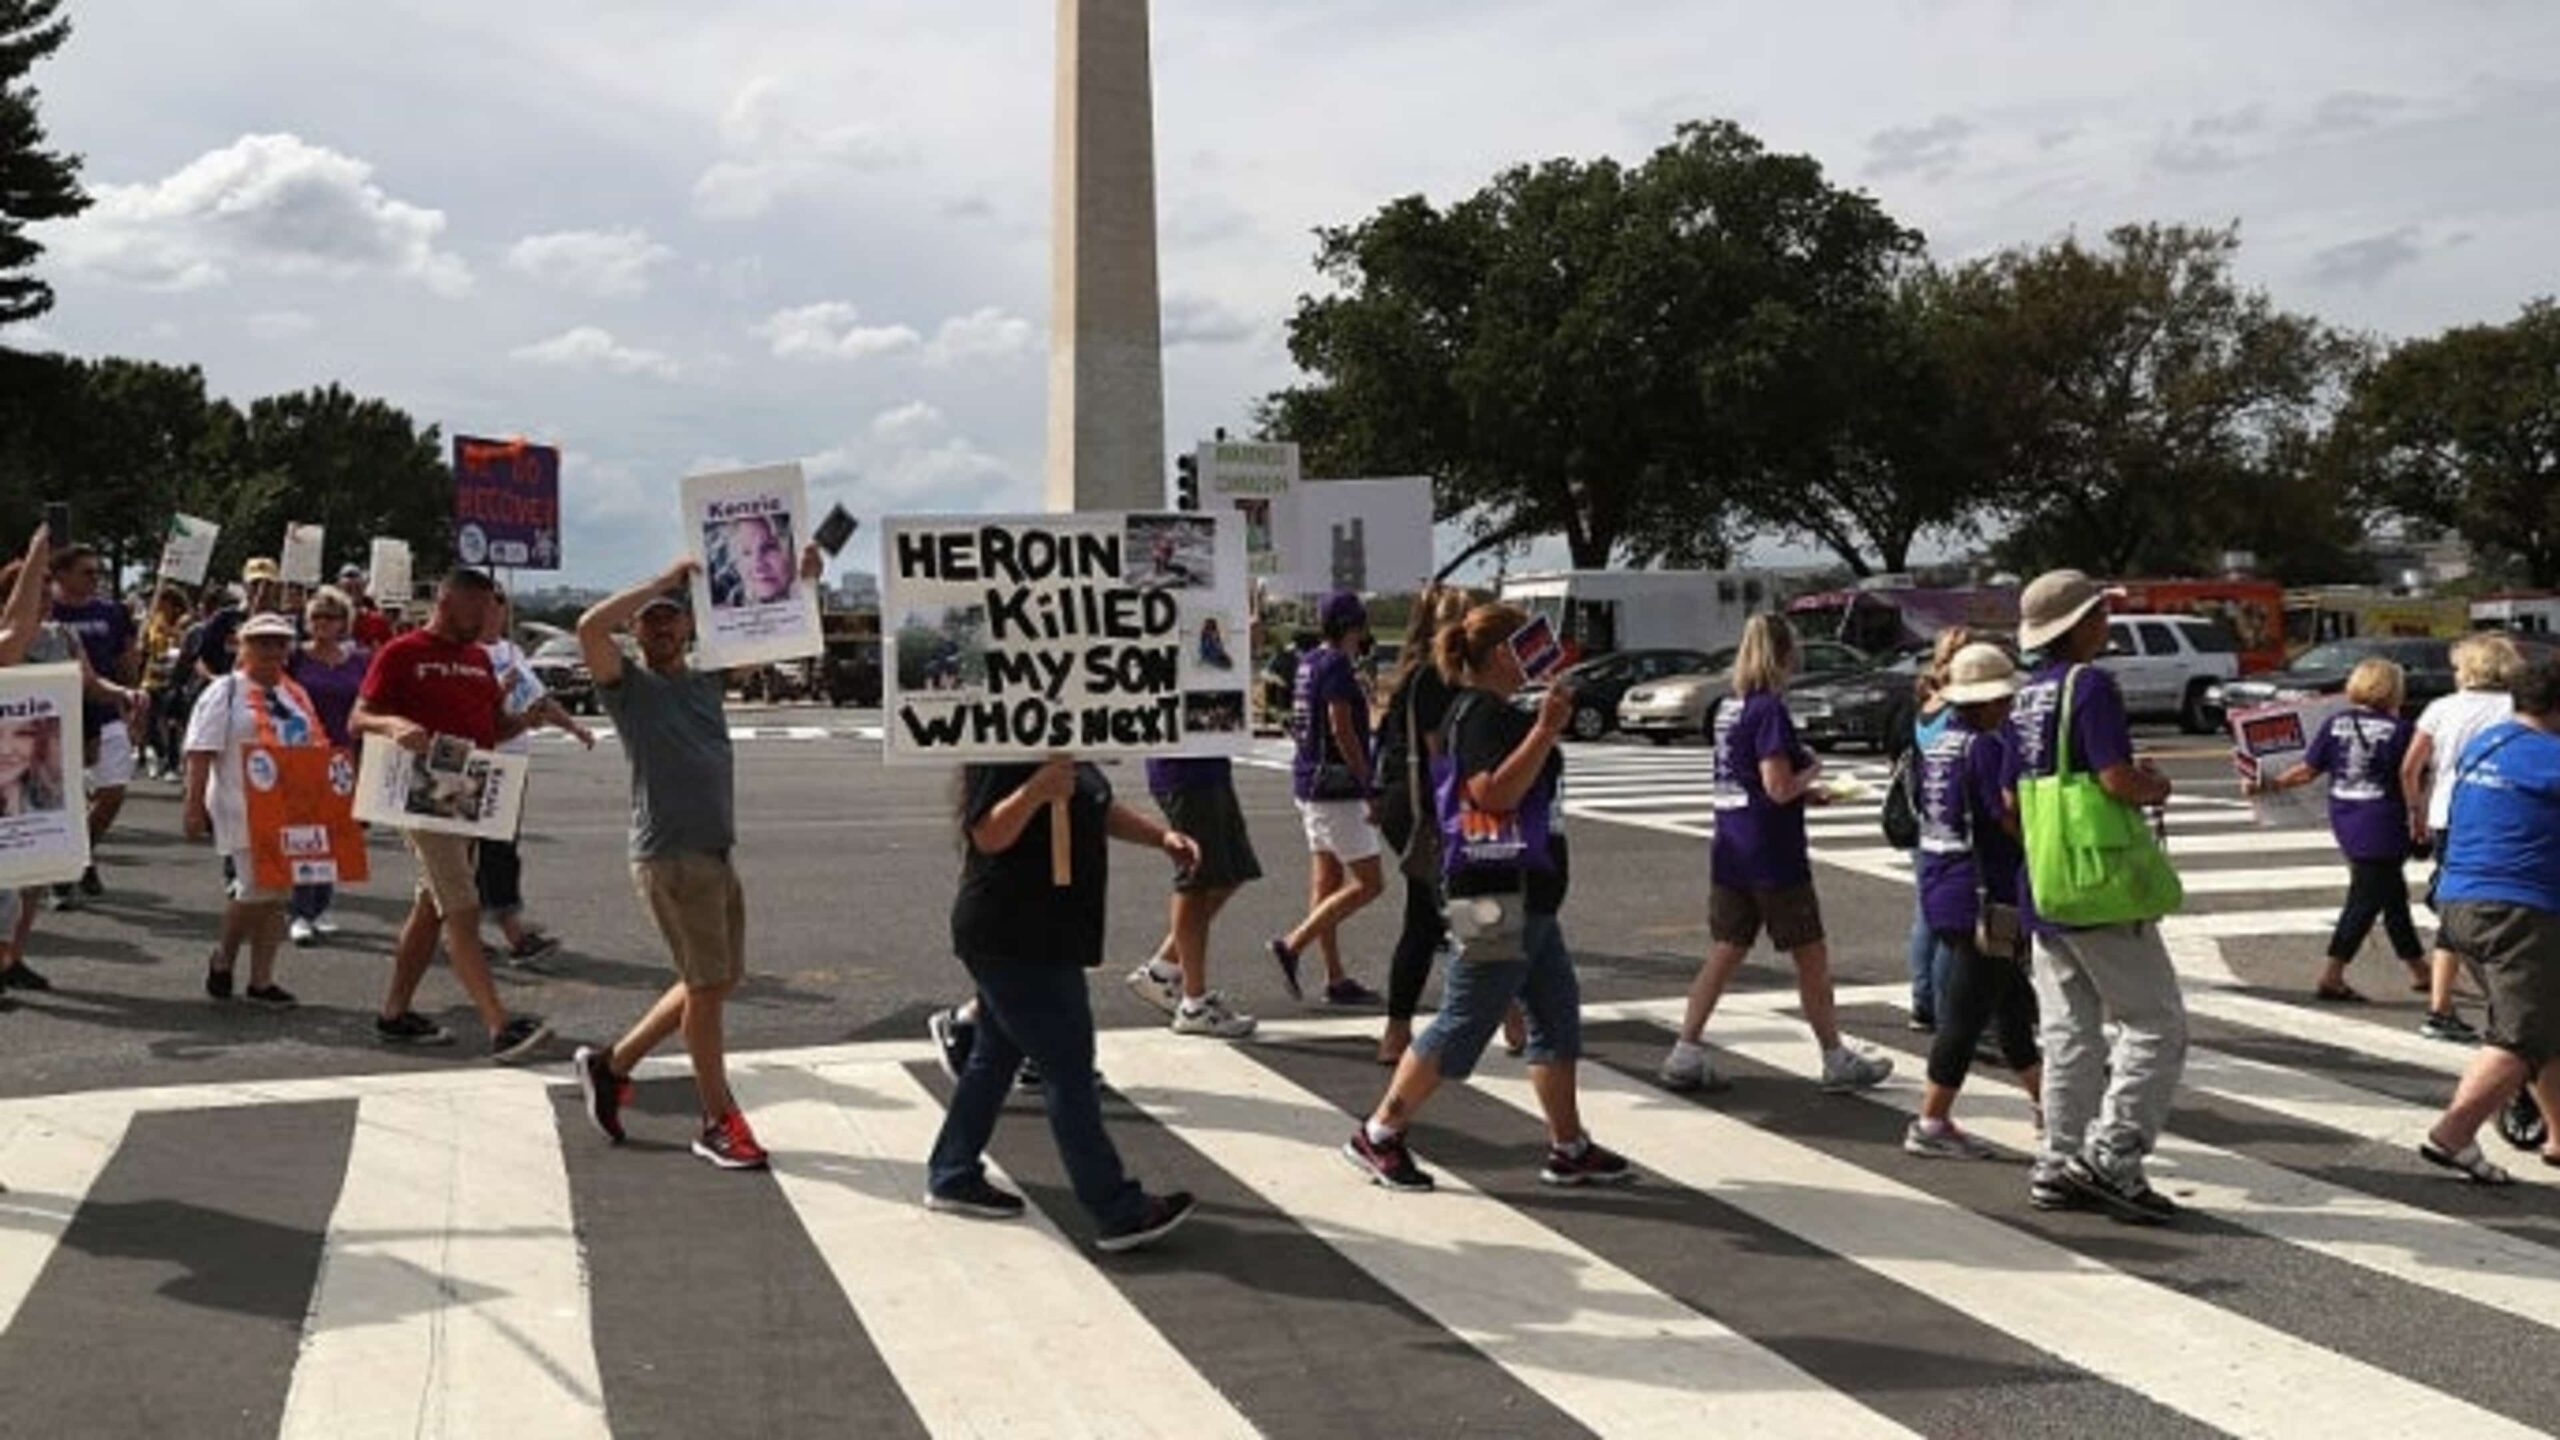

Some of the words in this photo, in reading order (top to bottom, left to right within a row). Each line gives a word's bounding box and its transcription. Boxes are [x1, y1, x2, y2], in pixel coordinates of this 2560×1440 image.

[709, 493, 781, 518] Kenzie
[897, 526, 1121, 585] HEROIN
[1083, 644, 1179, 695] SON
